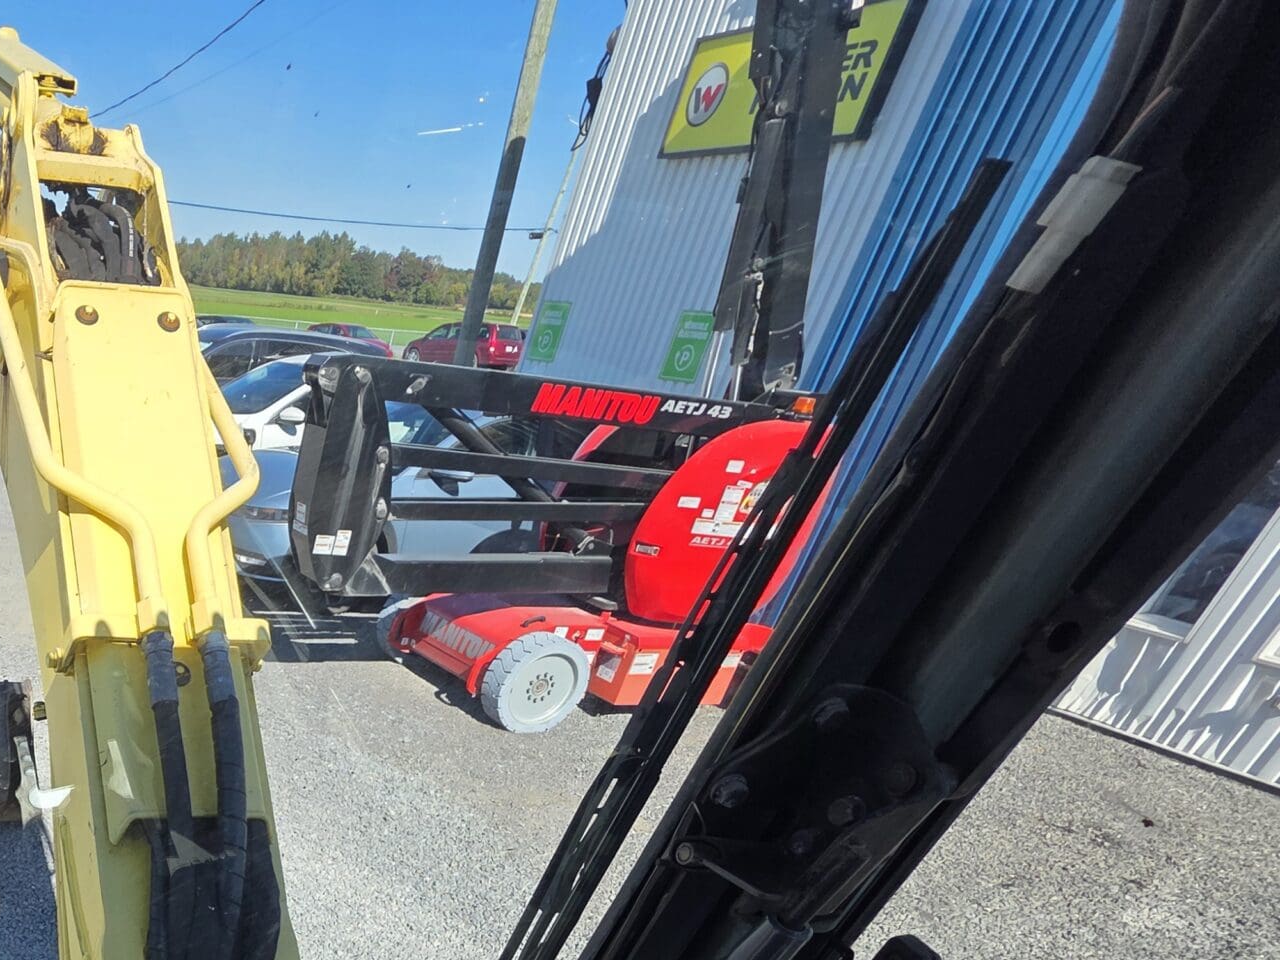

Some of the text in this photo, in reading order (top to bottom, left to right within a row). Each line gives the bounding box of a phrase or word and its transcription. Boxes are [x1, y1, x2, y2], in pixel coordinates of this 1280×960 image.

[531, 383, 733, 424] MANITOU AETJ 43
[691, 536, 728, 546] AETJ
